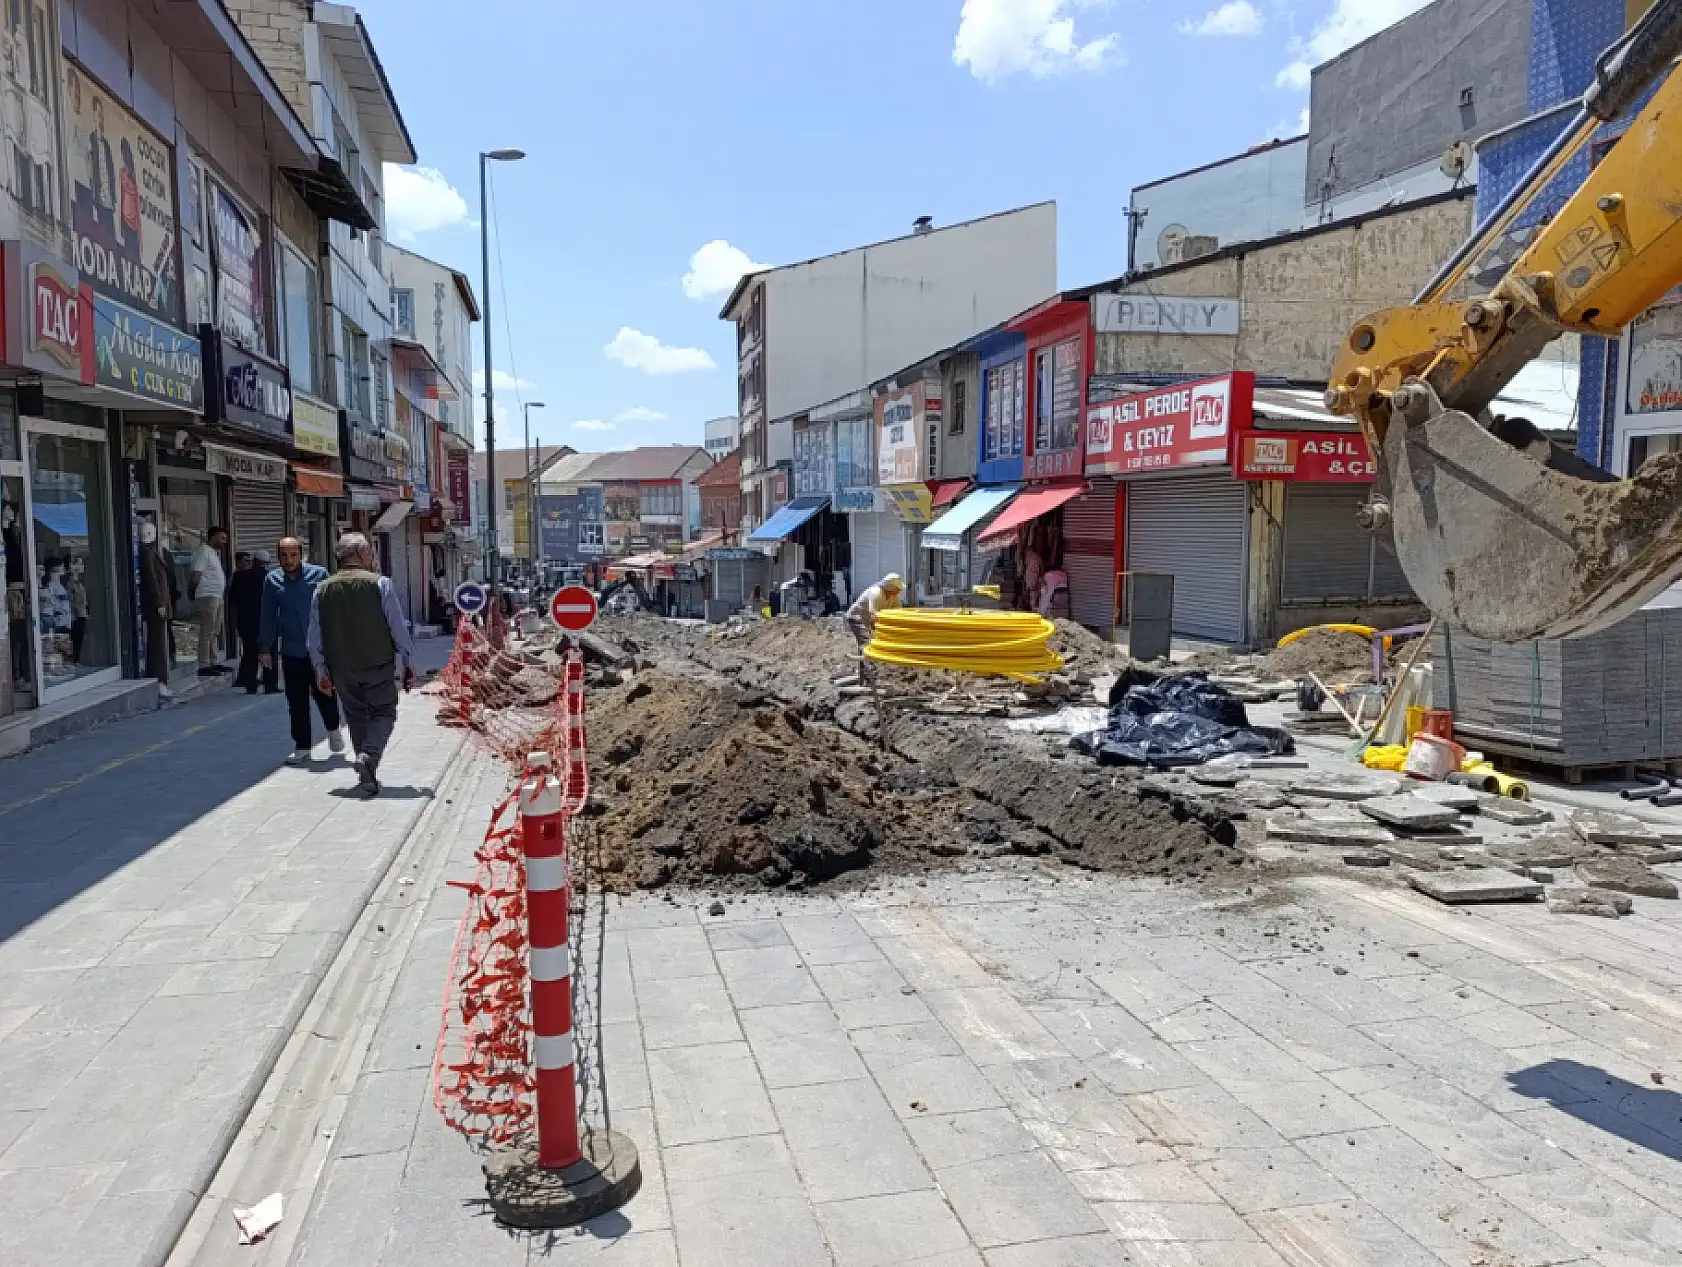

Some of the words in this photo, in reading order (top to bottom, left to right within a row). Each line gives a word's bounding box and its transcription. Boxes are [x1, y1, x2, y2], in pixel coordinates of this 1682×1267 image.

[1117, 299, 1220, 328] PERRY
[1145, 389, 1191, 419] PERDE
[1301, 437, 1359, 455] ASİL
[226, 455, 253, 472] MODA
